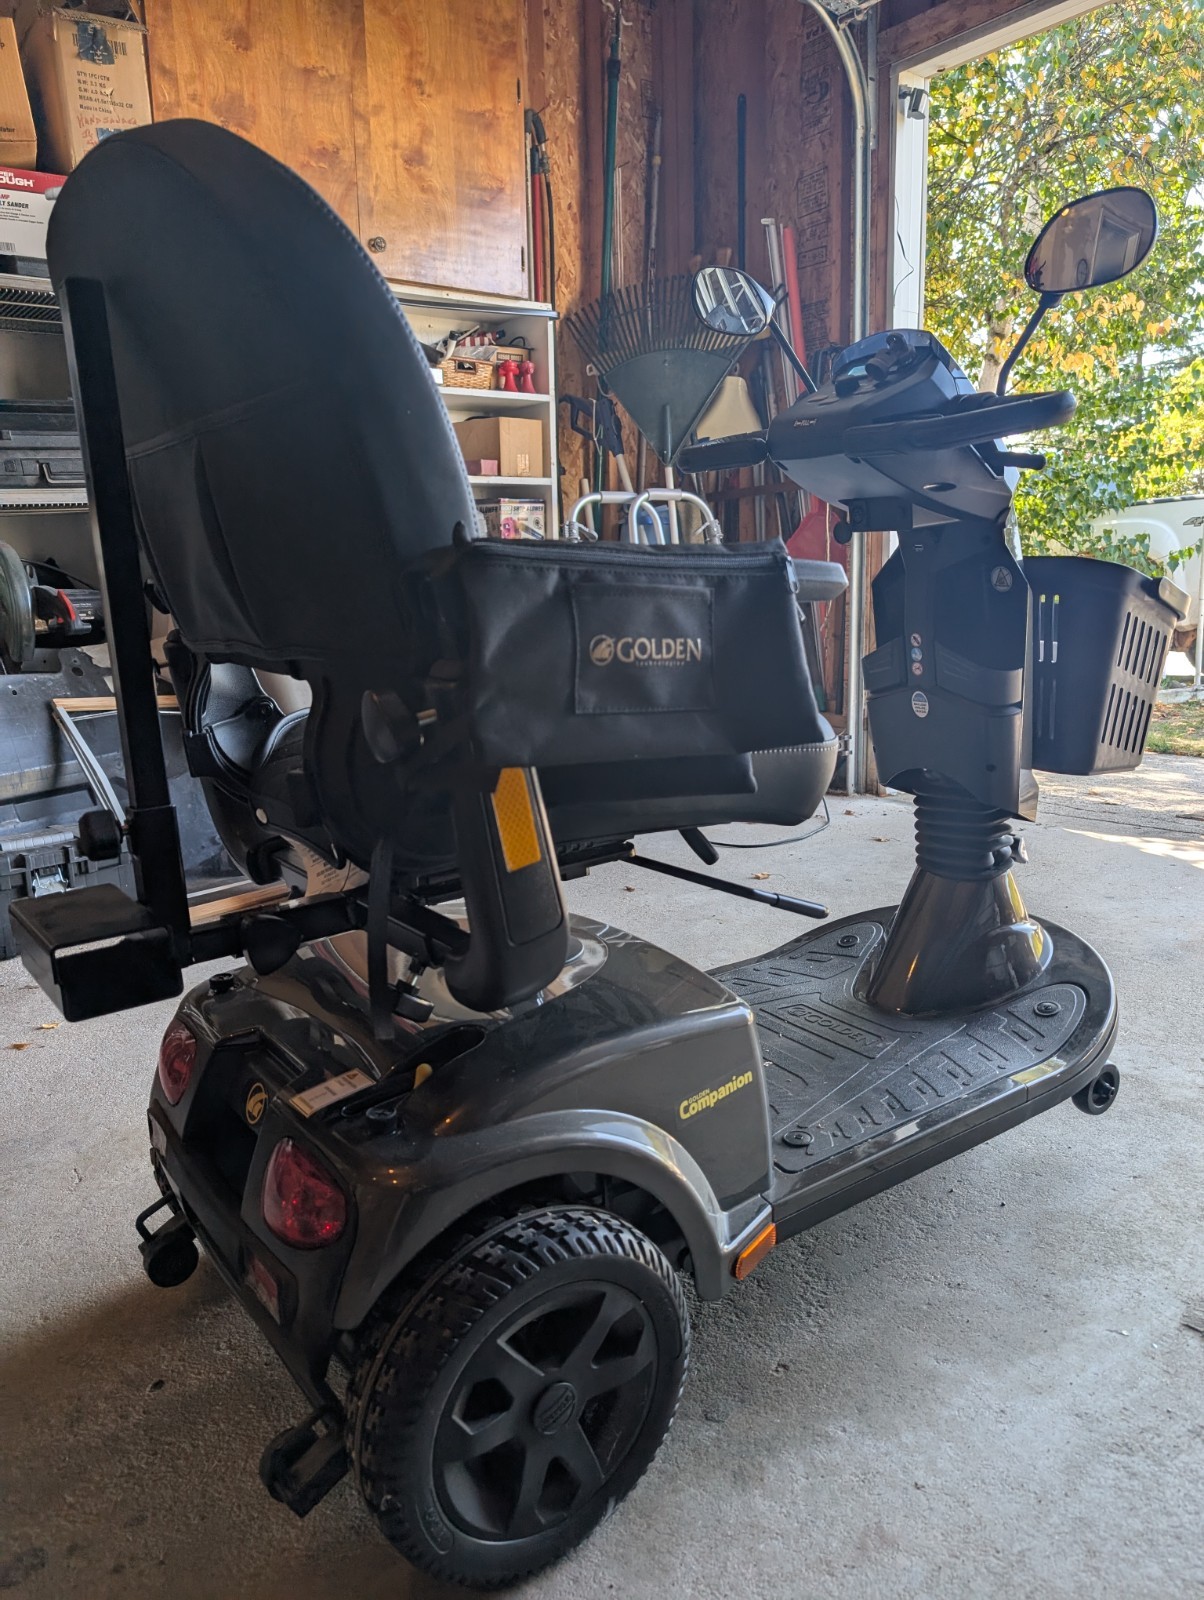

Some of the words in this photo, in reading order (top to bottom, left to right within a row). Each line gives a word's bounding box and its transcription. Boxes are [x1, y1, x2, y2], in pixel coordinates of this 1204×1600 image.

[7, 201, 29, 209] SANDER
[616, 637, 701, 662] GOLDEN
[805, 1013, 880, 1047] GOLDEN
[679, 1070, 753, 1120] Companion
[688, 1088, 710, 1104] GOLDEN
